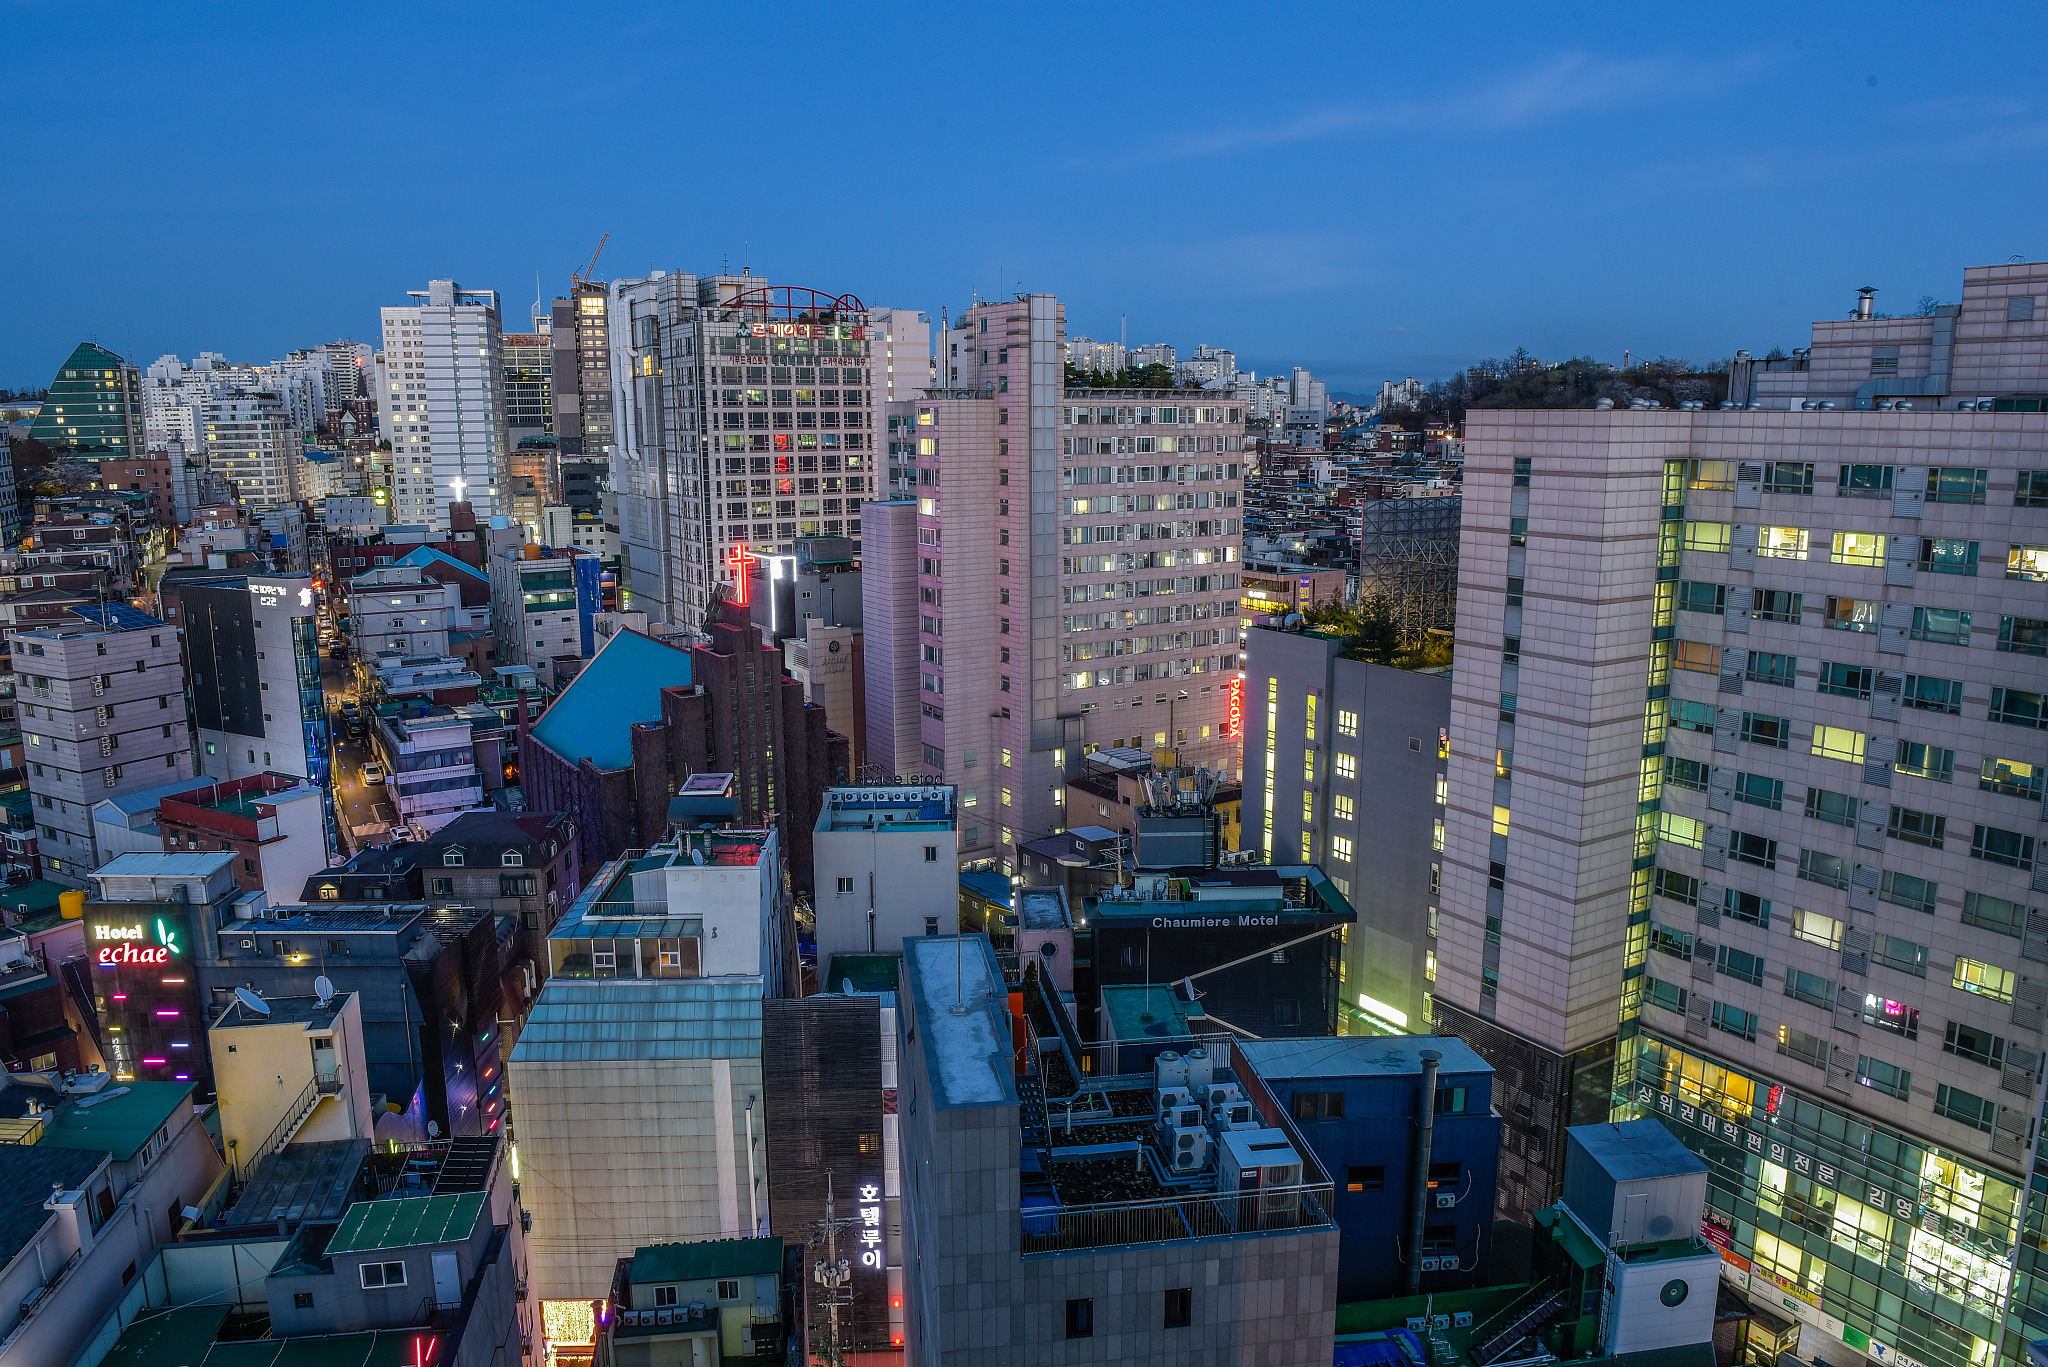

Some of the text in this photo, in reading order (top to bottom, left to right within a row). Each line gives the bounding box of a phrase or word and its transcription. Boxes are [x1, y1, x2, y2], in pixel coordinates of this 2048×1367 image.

[1229, 677, 1241, 739] PAGODA
[94, 924, 144, 940] Hotel
[1152, 915, 1279, 929] Chaumiere Motel
[99, 941, 168, 964] echae
[859, 1184, 882, 1270] 호텔루이
